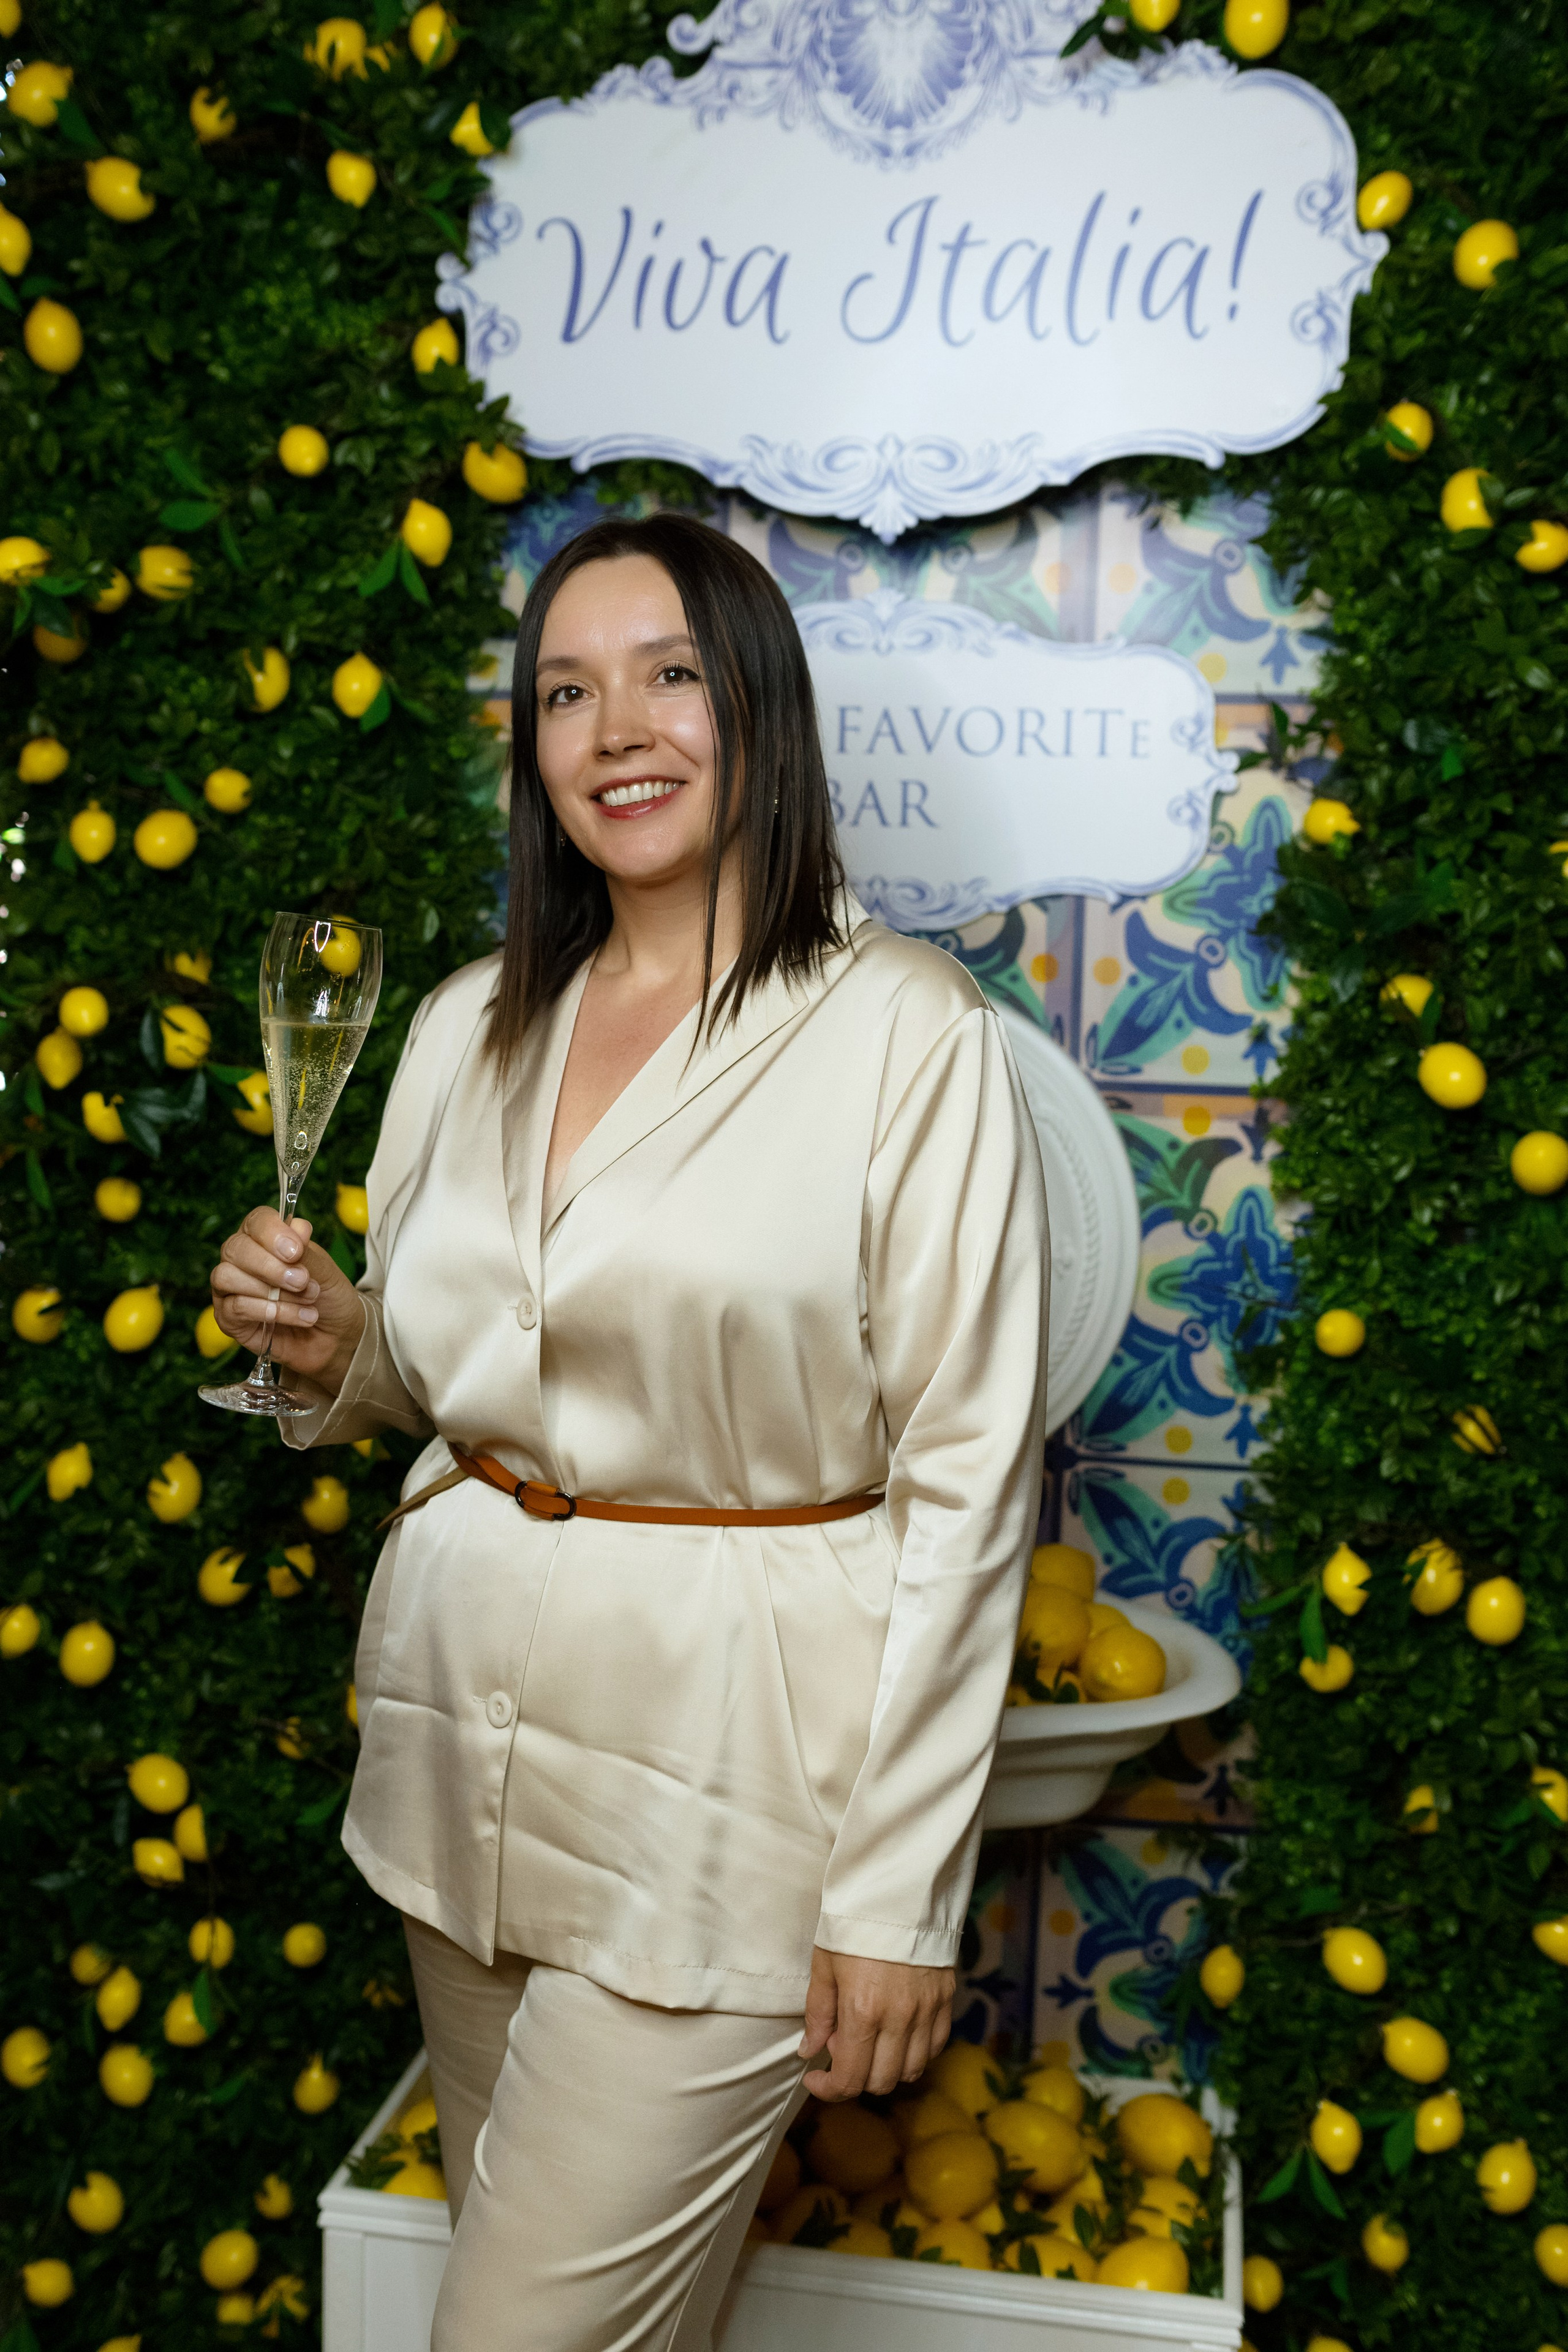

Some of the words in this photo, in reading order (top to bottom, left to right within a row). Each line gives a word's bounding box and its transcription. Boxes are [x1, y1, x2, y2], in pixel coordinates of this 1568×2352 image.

[536, 205, 791, 344] Viva
[840, 189, 1265, 348] Italia!
[835, 705, 1150, 758] FAVORITE
